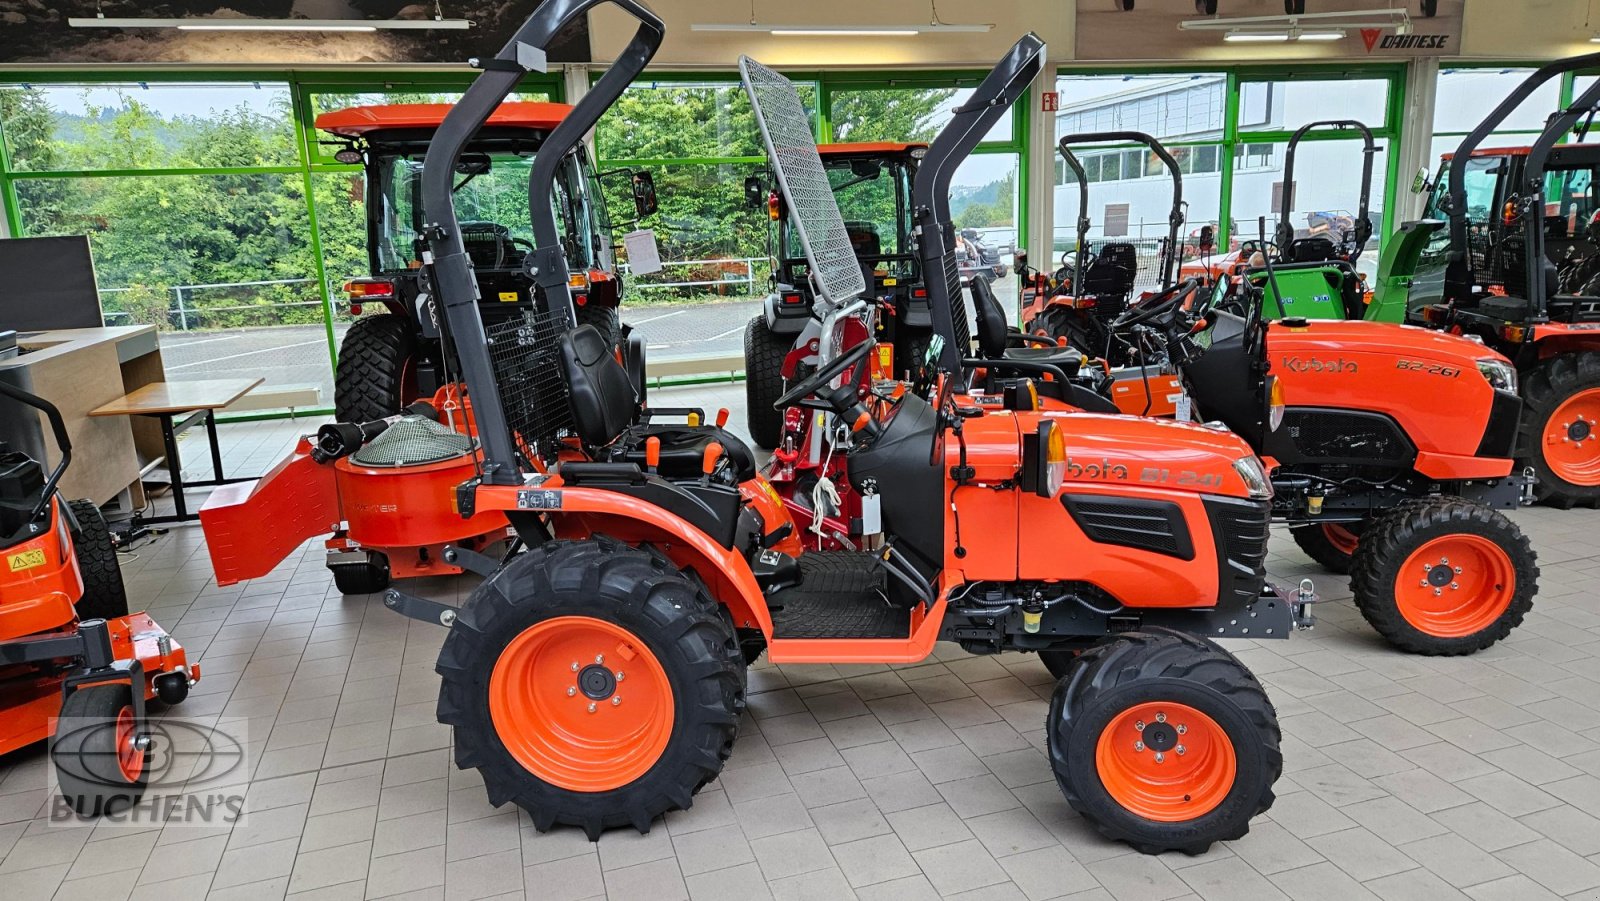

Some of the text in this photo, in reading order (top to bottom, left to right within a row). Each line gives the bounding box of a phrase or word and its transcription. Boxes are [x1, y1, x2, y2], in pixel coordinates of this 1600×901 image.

[1380, 34, 1450, 49] DAINESE
[1282, 356, 1461, 379] Kubota B2-261
[1066, 457, 1224, 488] bota B1-241
